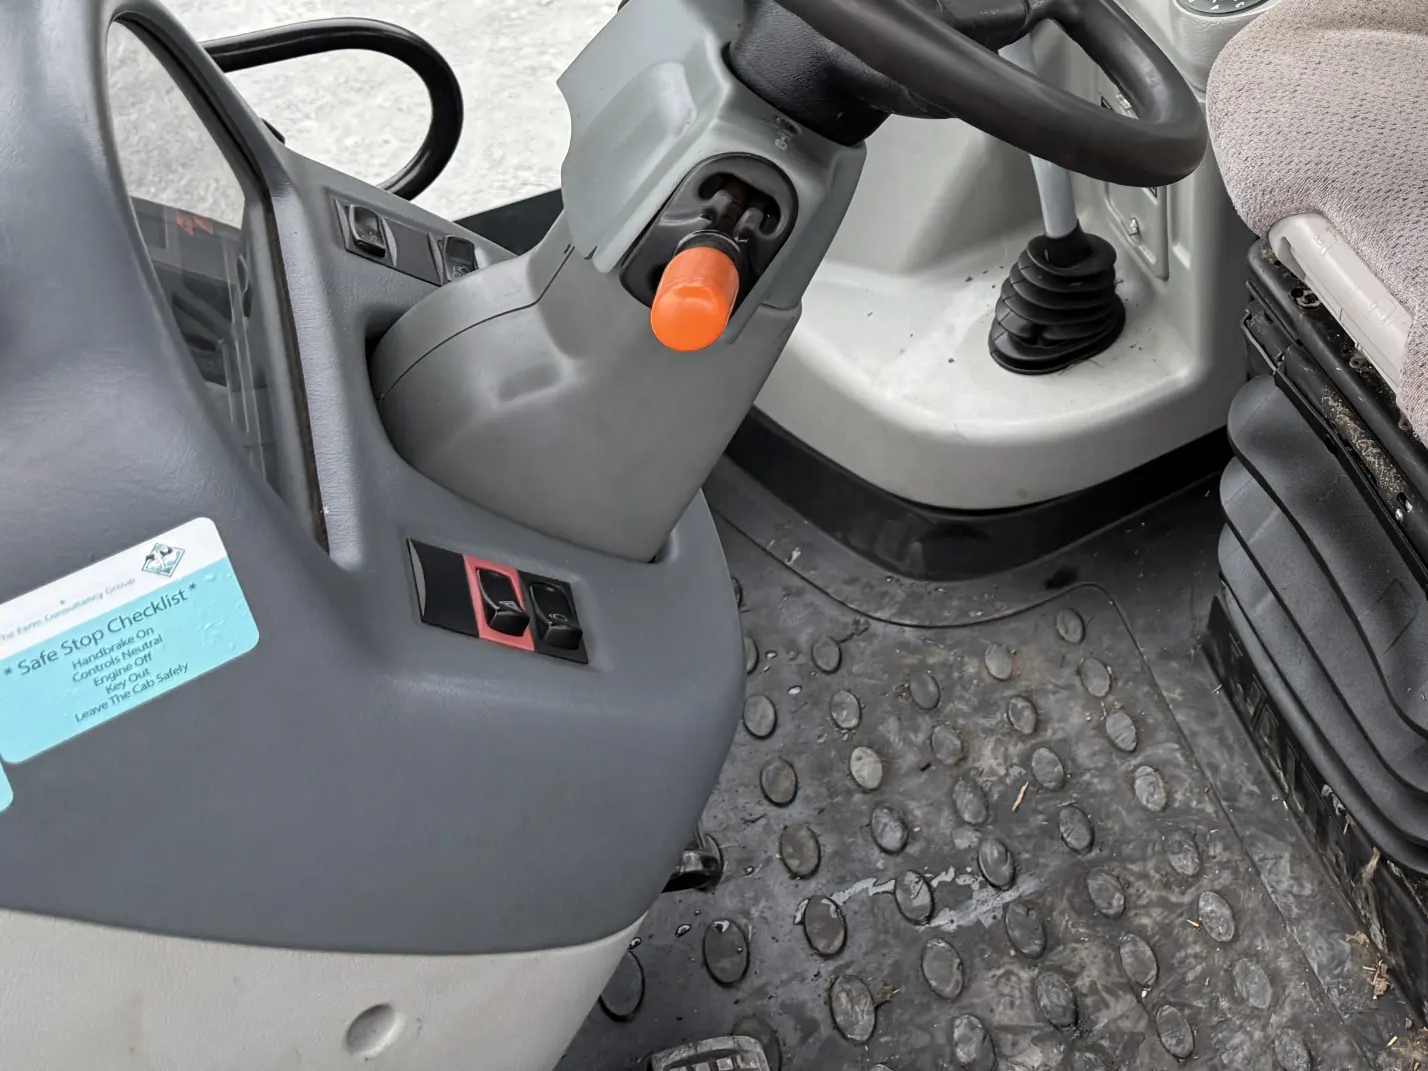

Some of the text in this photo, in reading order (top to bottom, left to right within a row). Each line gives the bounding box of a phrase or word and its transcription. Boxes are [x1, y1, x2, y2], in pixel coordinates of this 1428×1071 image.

[105, 577, 136, 595] Group
[17, 589, 188, 676] Safe Stop Checklist
[72, 627, 155, 670] Handbrake On
[72, 634, 164, 683] Controls Neutral
[92, 651, 153, 687] Engine Off
[74, 662, 189, 723] Leave The Cab Safely
[105, 668, 151, 695] Key Out
